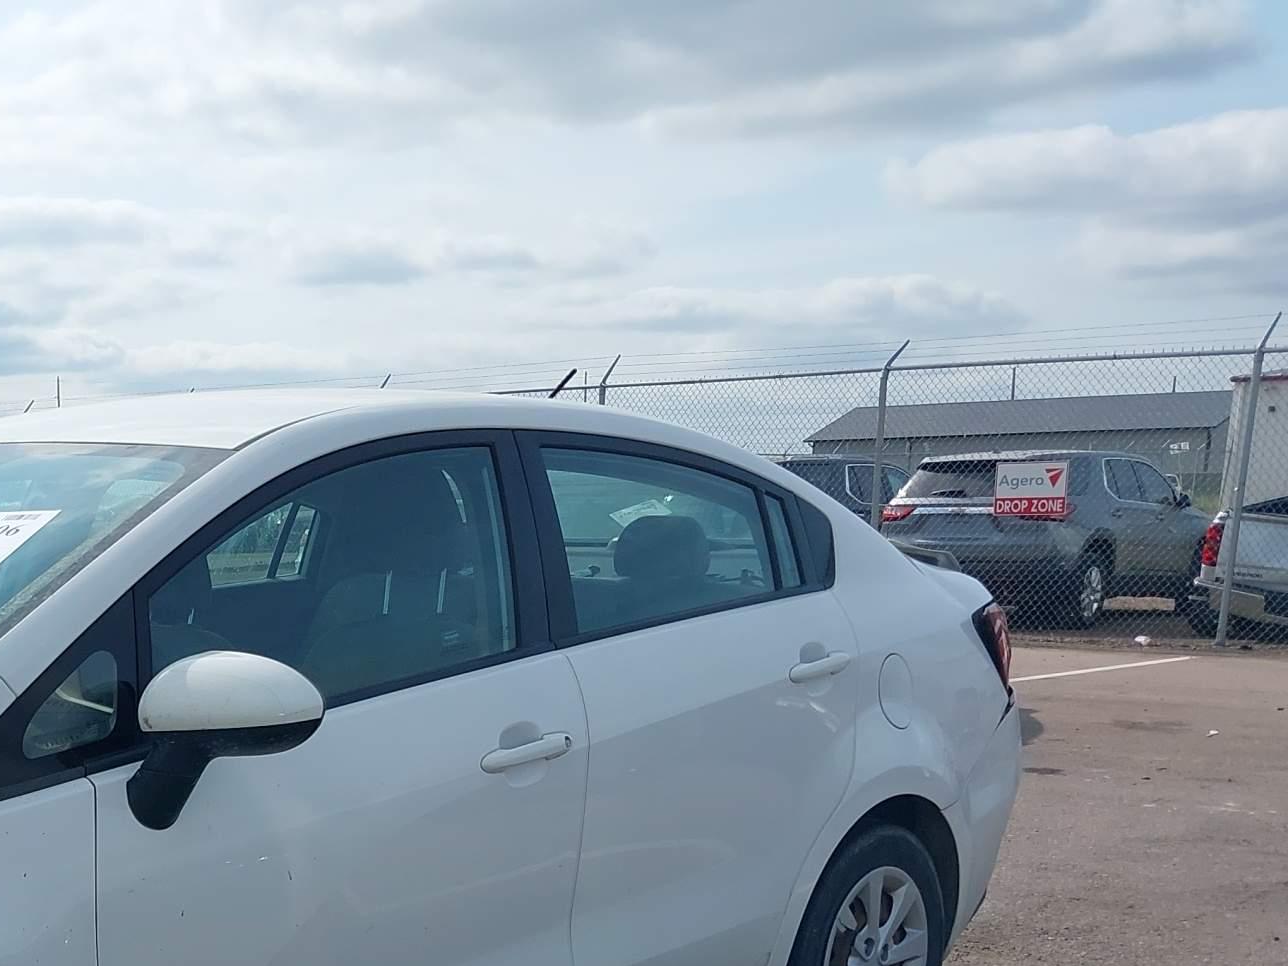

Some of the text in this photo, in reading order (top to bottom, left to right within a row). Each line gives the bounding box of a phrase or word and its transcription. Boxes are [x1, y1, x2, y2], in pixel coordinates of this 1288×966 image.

[999, 474, 1044, 490] Agero
[996, 499, 1064, 513] DROP ZONE
